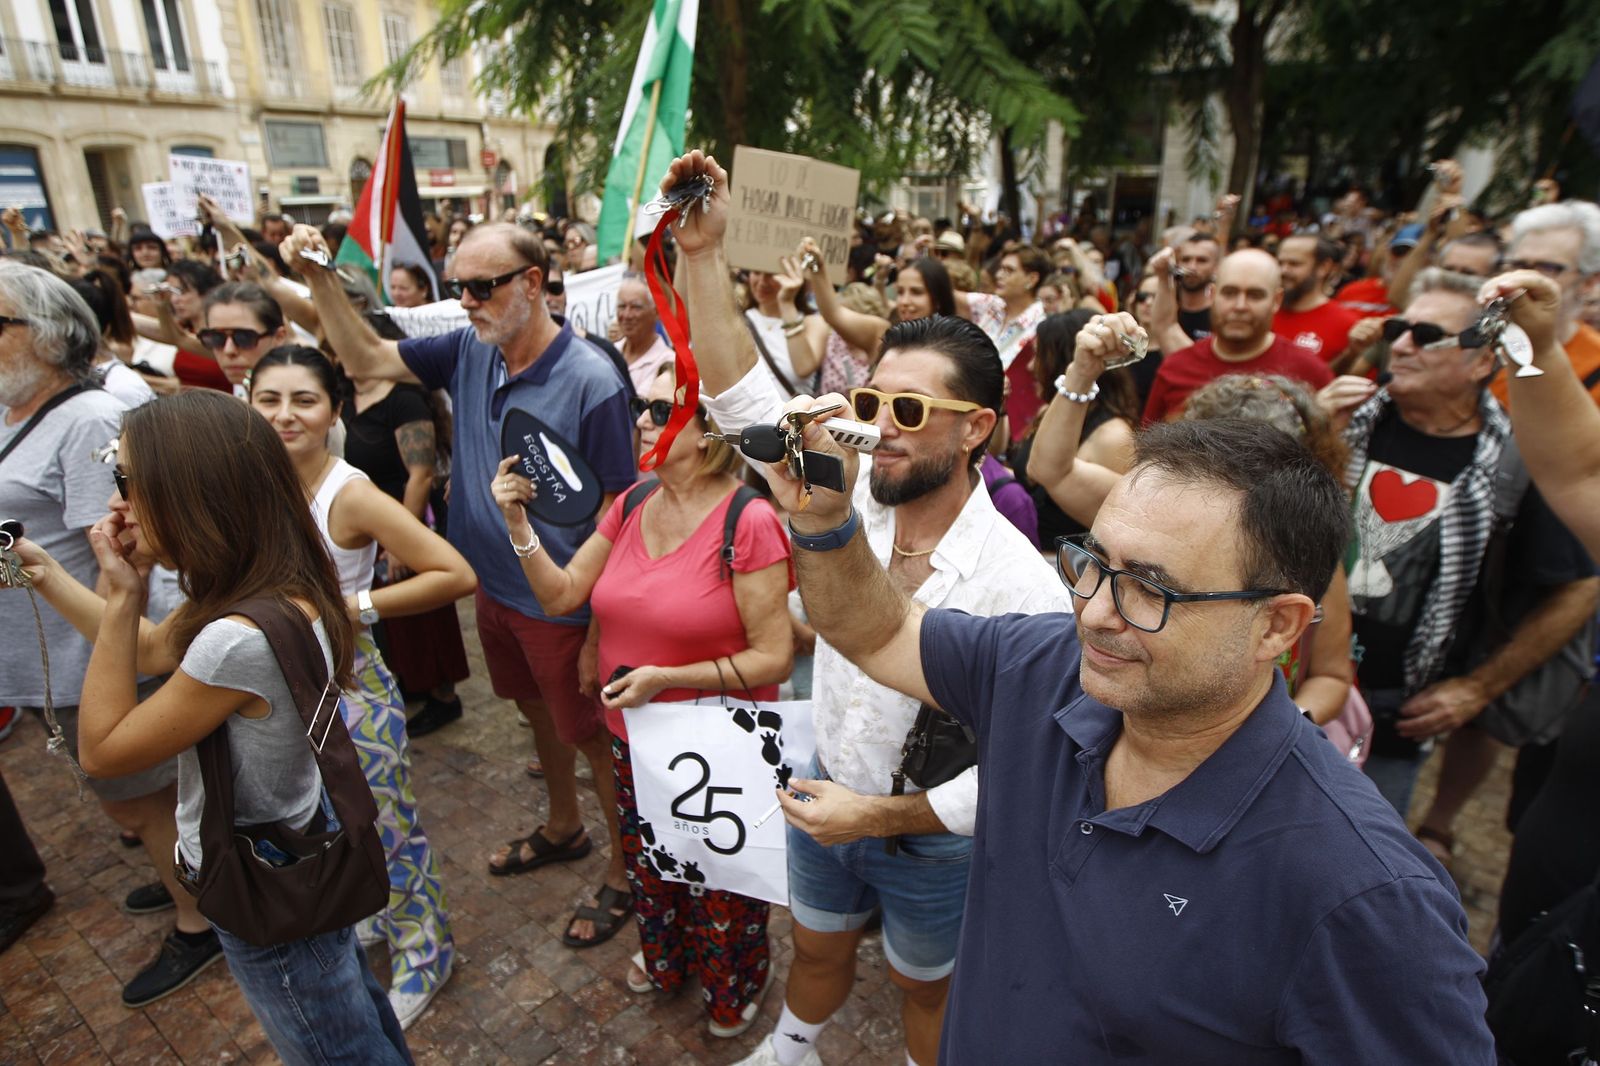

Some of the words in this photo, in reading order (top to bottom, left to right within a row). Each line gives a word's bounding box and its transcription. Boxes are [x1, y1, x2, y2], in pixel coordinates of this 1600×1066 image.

[820, 232, 849, 265] CARO
[522, 457, 541, 482] HOT
[523, 433, 567, 503] EGGSTRA
[668, 751, 746, 855] 25
[674, 821, 710, 836] años
